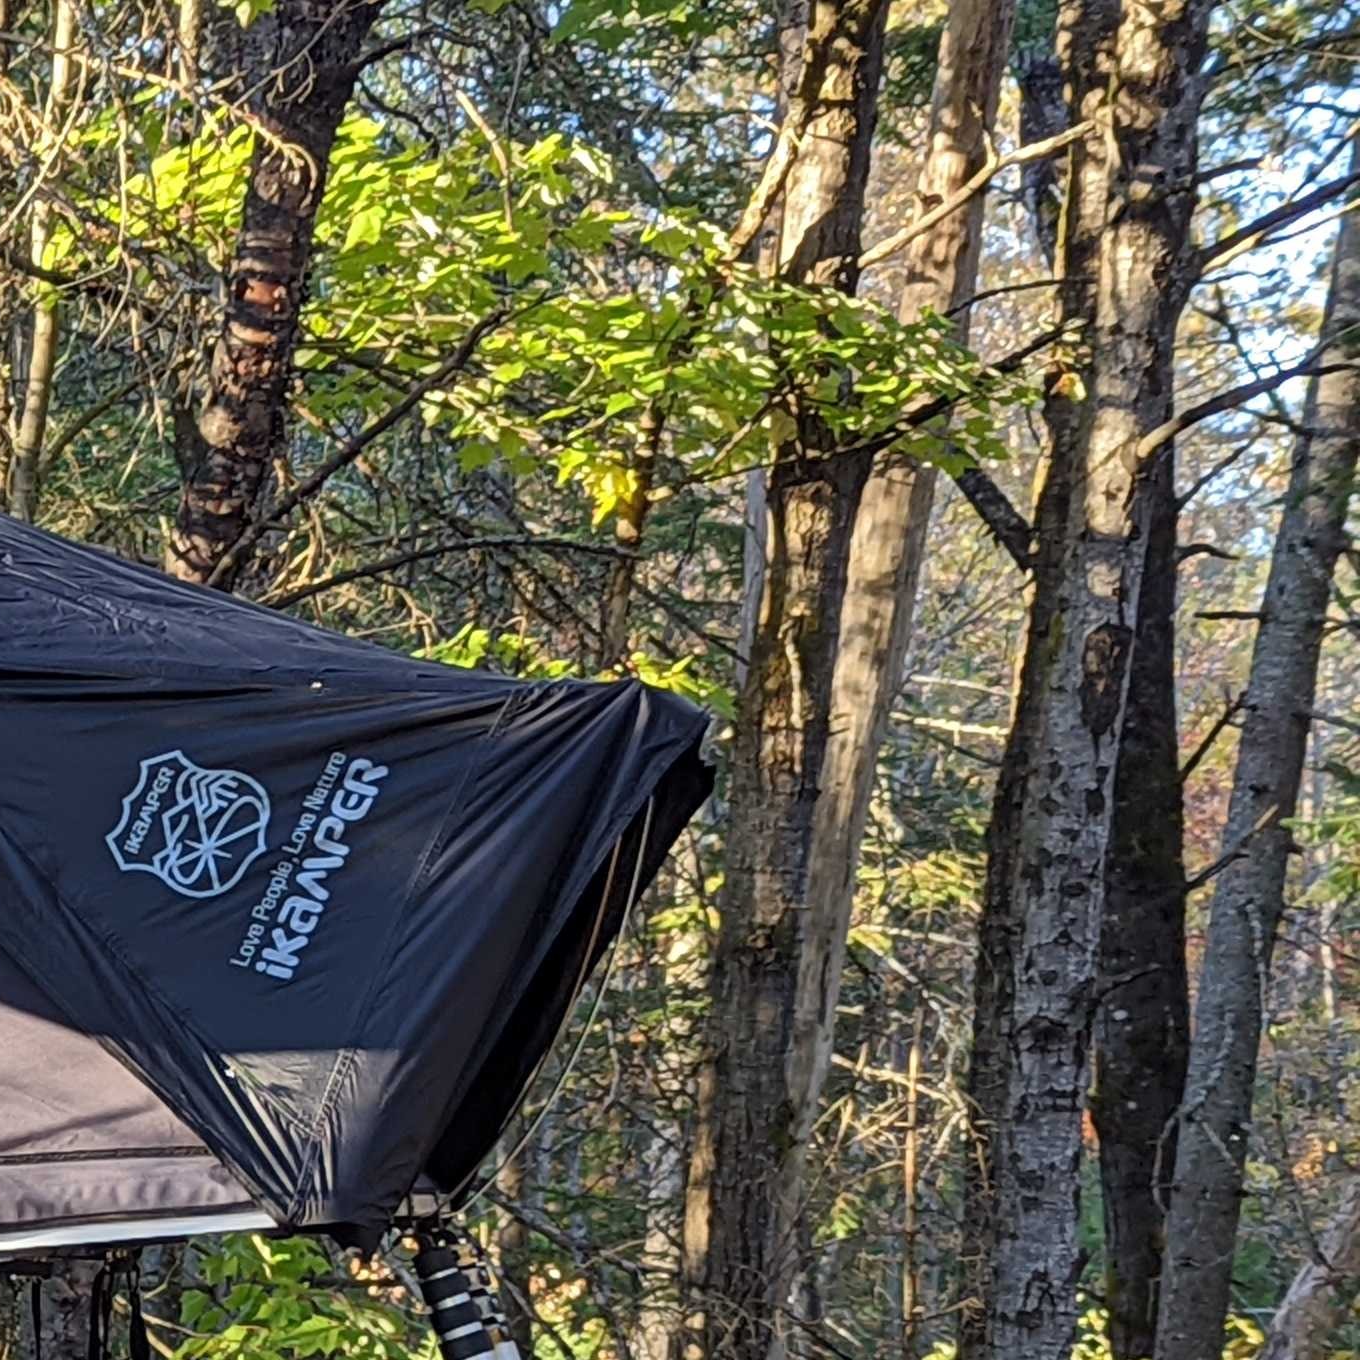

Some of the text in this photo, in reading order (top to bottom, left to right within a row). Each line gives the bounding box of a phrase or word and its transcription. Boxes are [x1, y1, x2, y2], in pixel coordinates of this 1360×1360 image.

[230, 923, 265, 968] Love
[281, 812, 318, 856] Love
[301, 751, 348, 812] Nature
